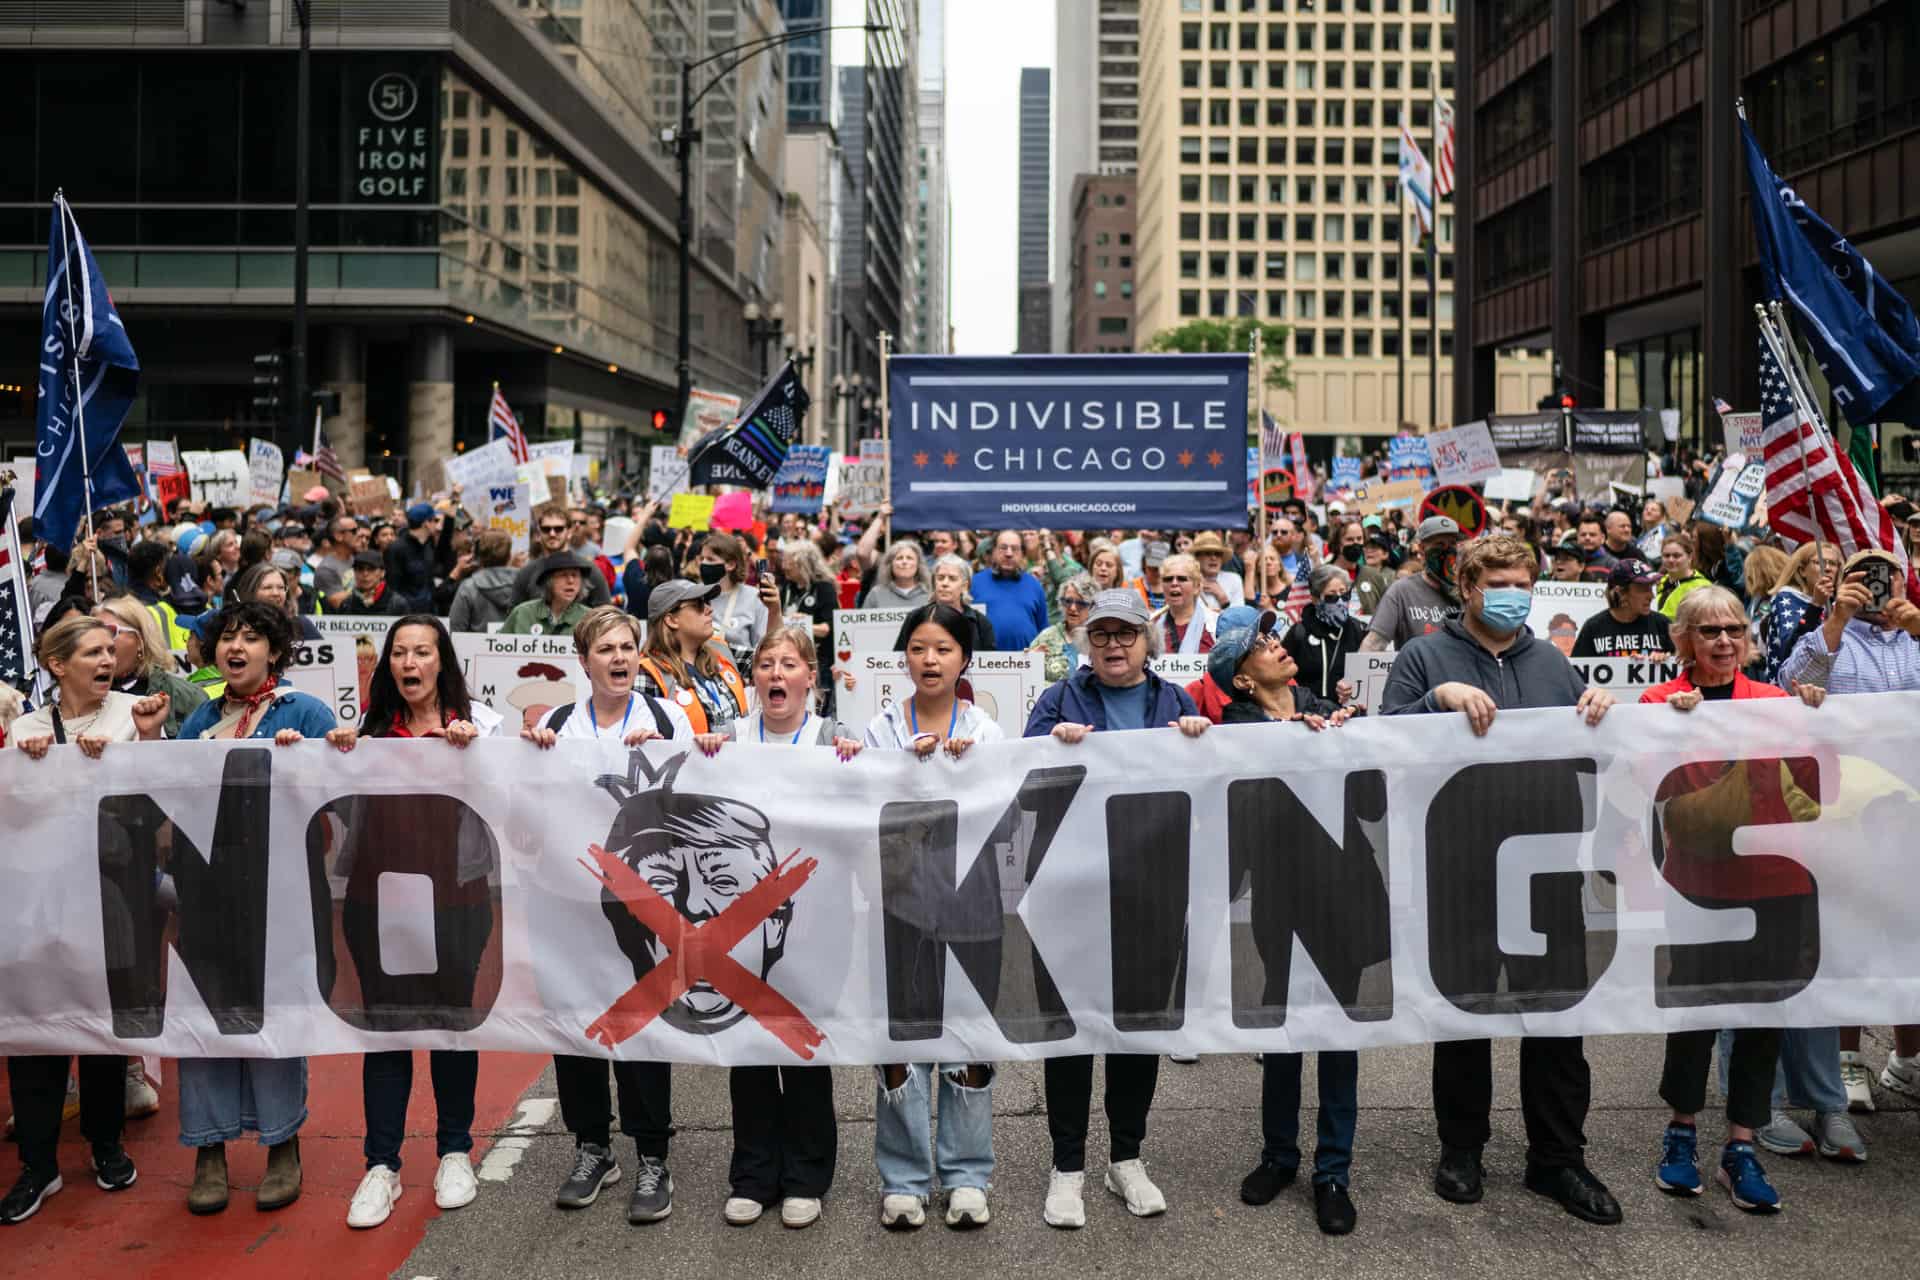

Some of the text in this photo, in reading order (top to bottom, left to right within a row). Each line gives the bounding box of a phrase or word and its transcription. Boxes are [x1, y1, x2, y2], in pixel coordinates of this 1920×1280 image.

[360, 127, 426, 146] FIVE
[359, 152, 425, 170] IRON
[359, 178, 425, 196] GOLF
[911, 401, 1227, 430] INDIVISIBLE
[974, 448, 1165, 471] CHICAGO
[1001, 503, 1137, 513] INDIVISIBLECHICAGO.COM
[840, 613, 867, 624] OUR
[329, 621, 388, 633] BELOVED
[486, 638, 518, 653] Tool
[522, 639, 538, 653] of
[542, 640, 567, 654] the
[838, 631, 851, 647] A
[1593, 633, 1663, 655] WE ARE ALL
[865, 656, 893, 669] Sec.
[978, 656, 1031, 669] Leeches
[1154, 660, 1167, 673] of
[1170, 660, 1190, 673] the
[98, 747, 1822, 1043] NO KINGS
